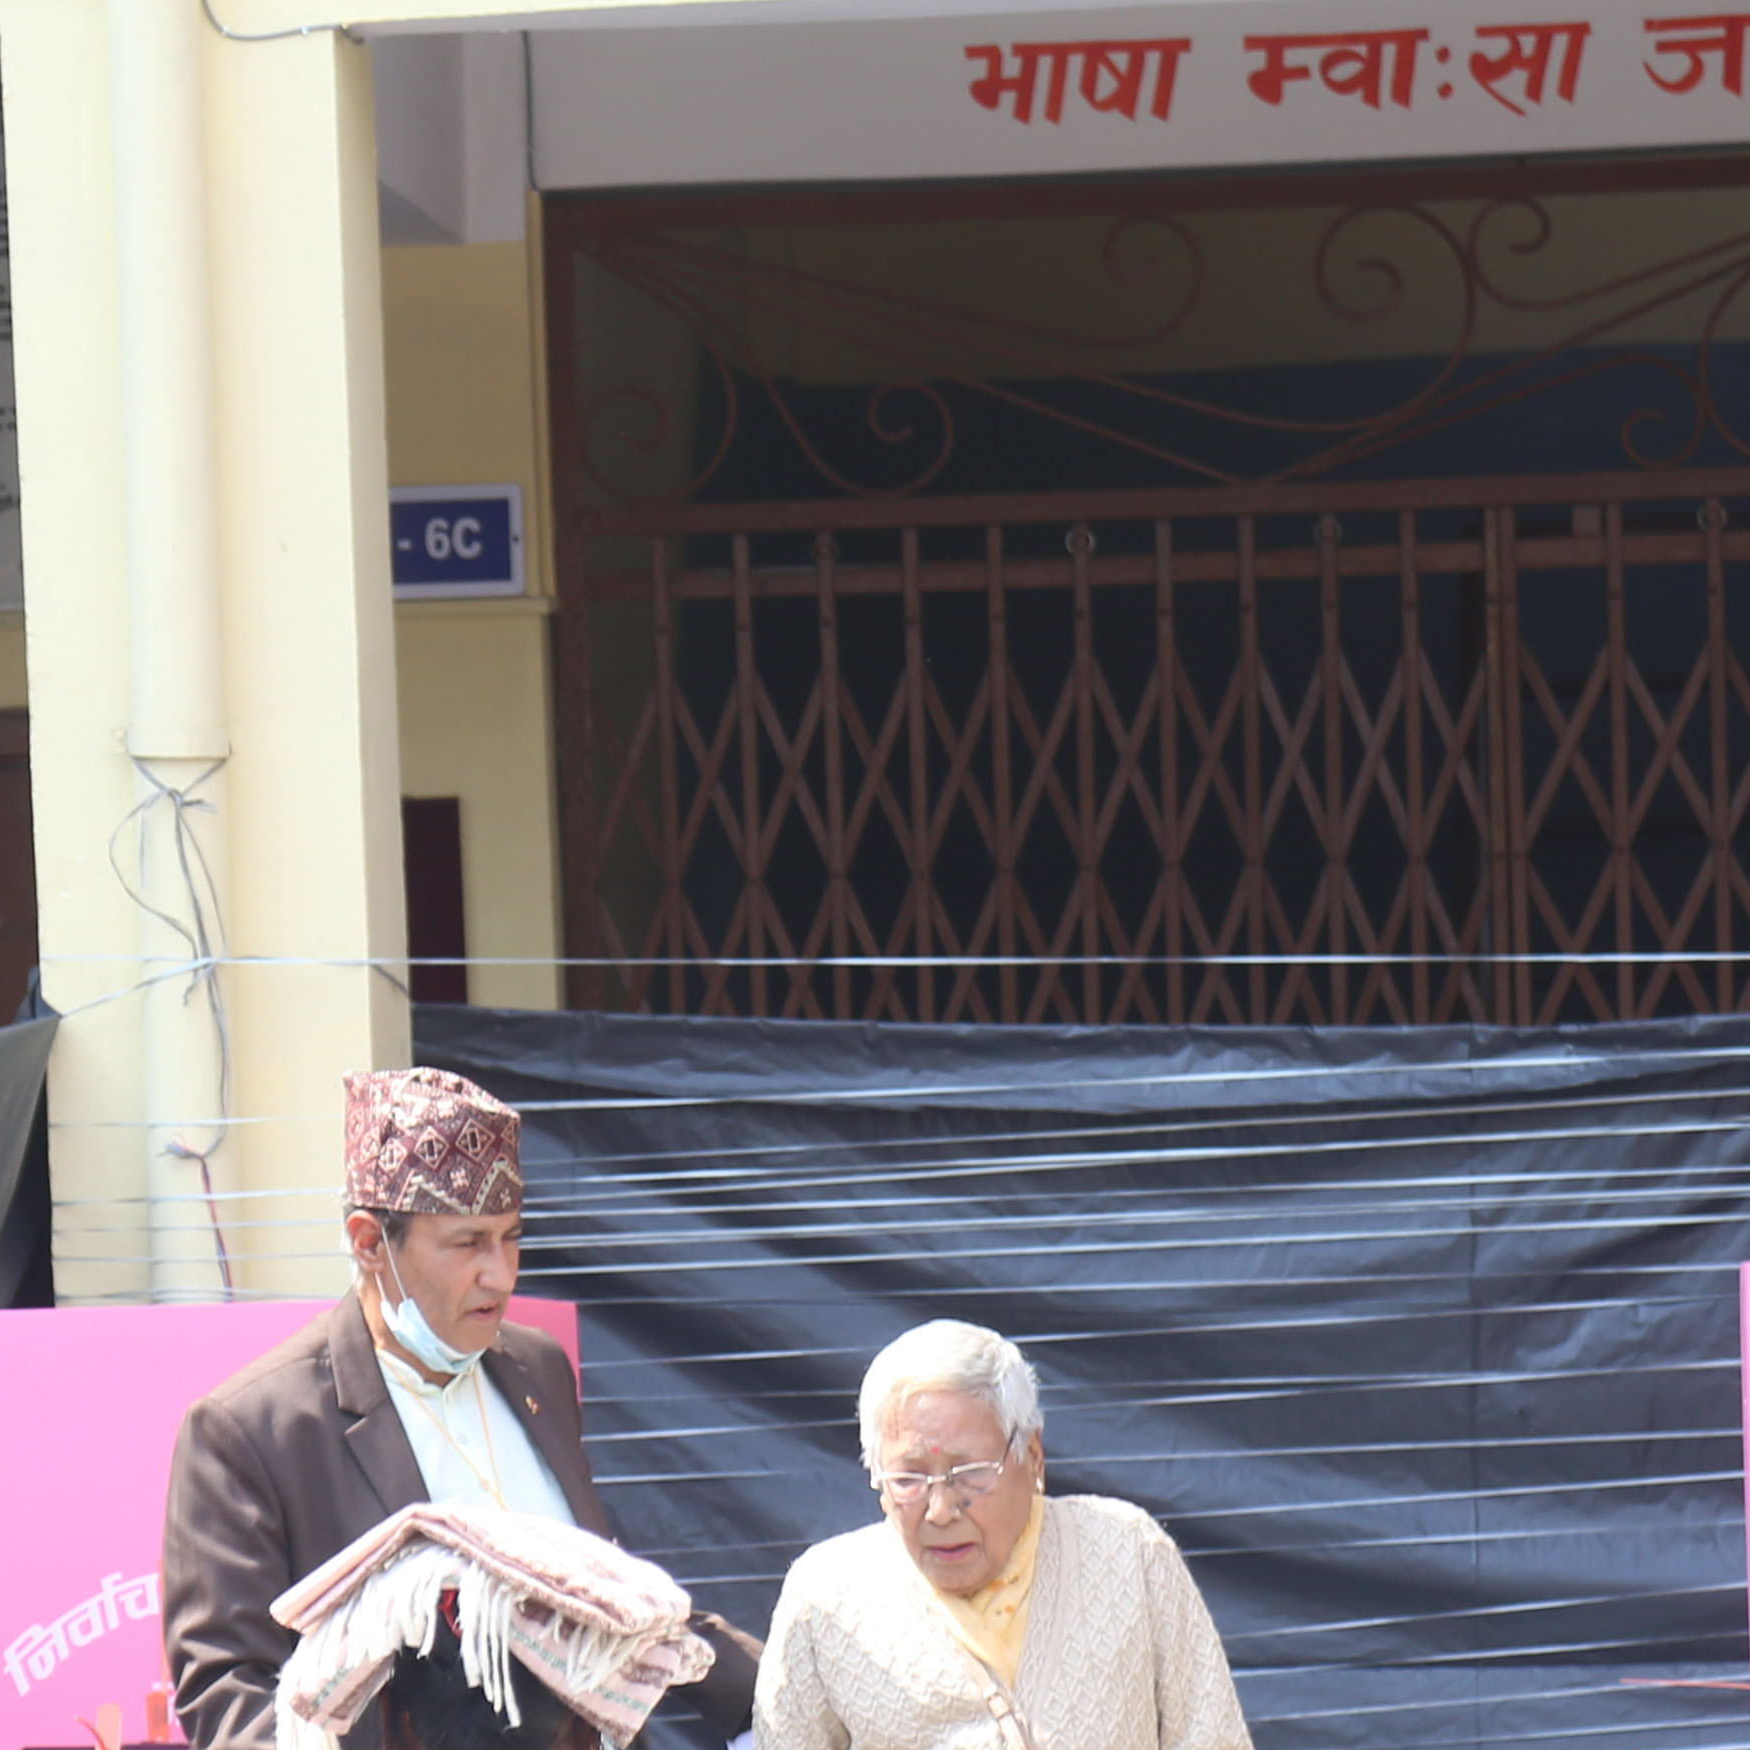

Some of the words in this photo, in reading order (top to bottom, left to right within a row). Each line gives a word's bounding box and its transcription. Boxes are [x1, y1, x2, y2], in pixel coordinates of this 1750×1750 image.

[964, 37, 1193, 126] भाषा
[424, 516, 483, 560] 6C
[3, 1571, 160, 1697] निर्वाच
